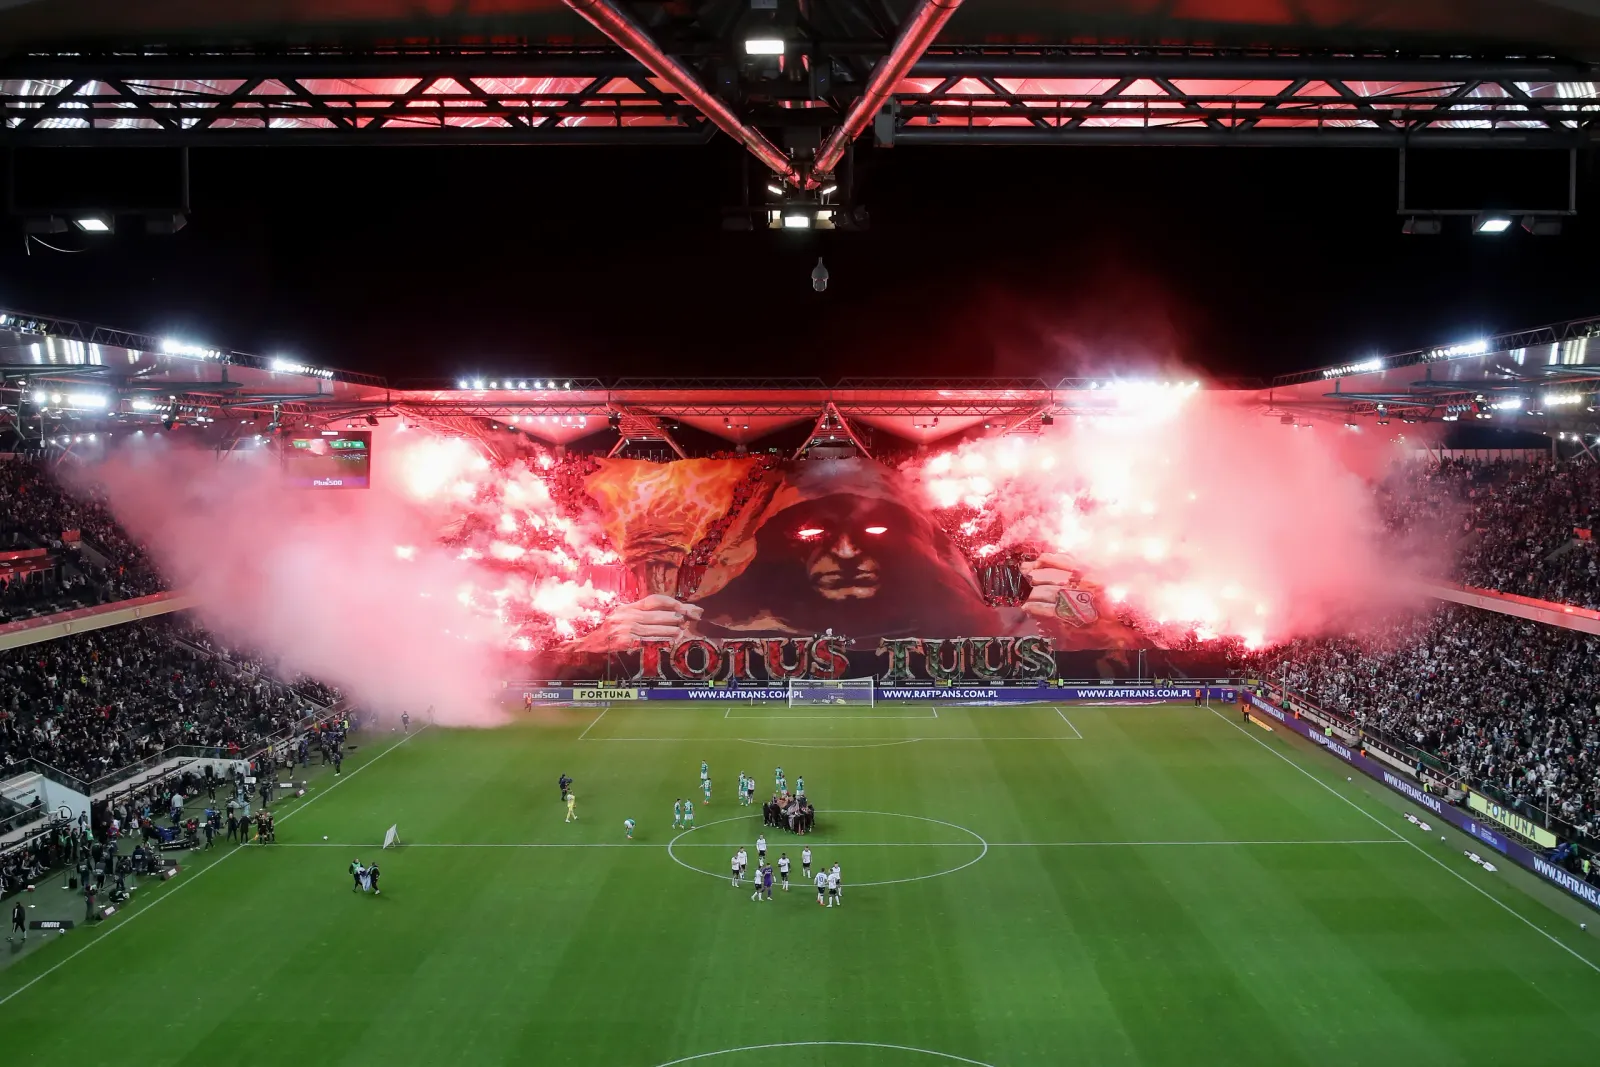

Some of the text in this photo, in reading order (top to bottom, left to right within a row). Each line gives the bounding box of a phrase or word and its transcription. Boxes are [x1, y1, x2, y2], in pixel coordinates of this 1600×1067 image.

[313, 478, 343, 486] Plus500
[627, 636, 1057, 681] TOTUS TUUS
[580, 690, 631, 698] FORTUNA
[688, 690, 804, 699] WWW.RAFTRANS.COM.PL
[883, 690, 998, 698] WWW.RAFTRANS.COM.PL
[1077, 689, 1192, 698] WWW.RAFTRANS.COM.PL
[1383, 771, 1442, 813] WWW.RAFTRANS.COM.PL
[1486, 800, 1536, 840] FORTUNA
